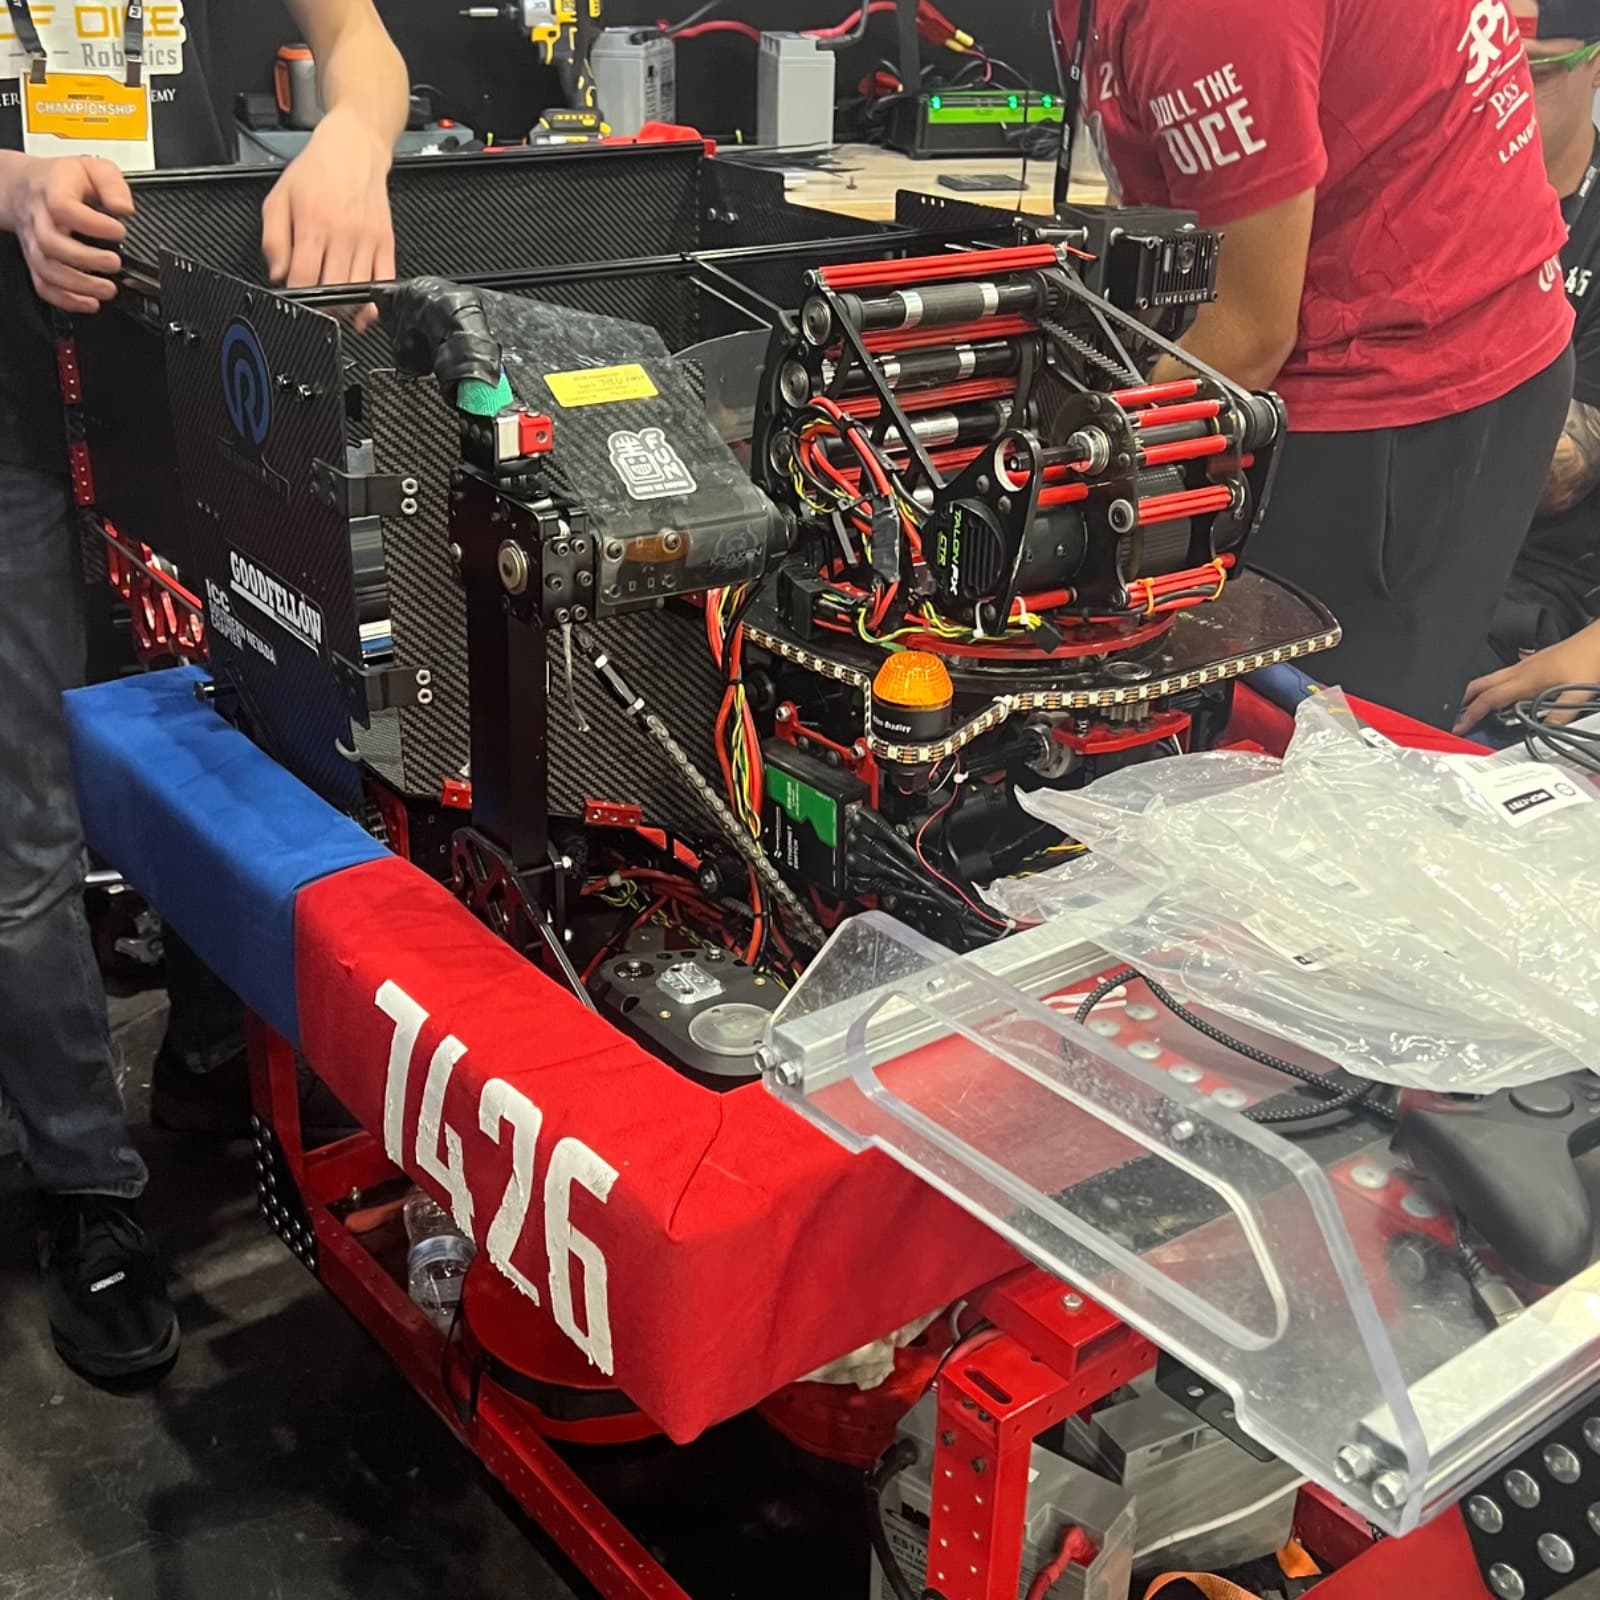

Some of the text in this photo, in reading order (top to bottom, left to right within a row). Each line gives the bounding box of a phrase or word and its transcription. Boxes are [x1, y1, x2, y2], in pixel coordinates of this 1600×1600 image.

[82, 42, 177, 68] Robics
[35, 101, 137, 116] CHAMPIONSHIP
[1193, 63, 1243, 109] THE
[1160, 97, 1267, 175] DICE
[1154, 291, 1208, 306] LIMELIGHT
[952, 510, 962, 564] TALON
[229, 550, 321, 644] GOODFELLOW
[245, 628, 277, 666] NEVADA
[374, 979, 620, 1377] 7426
